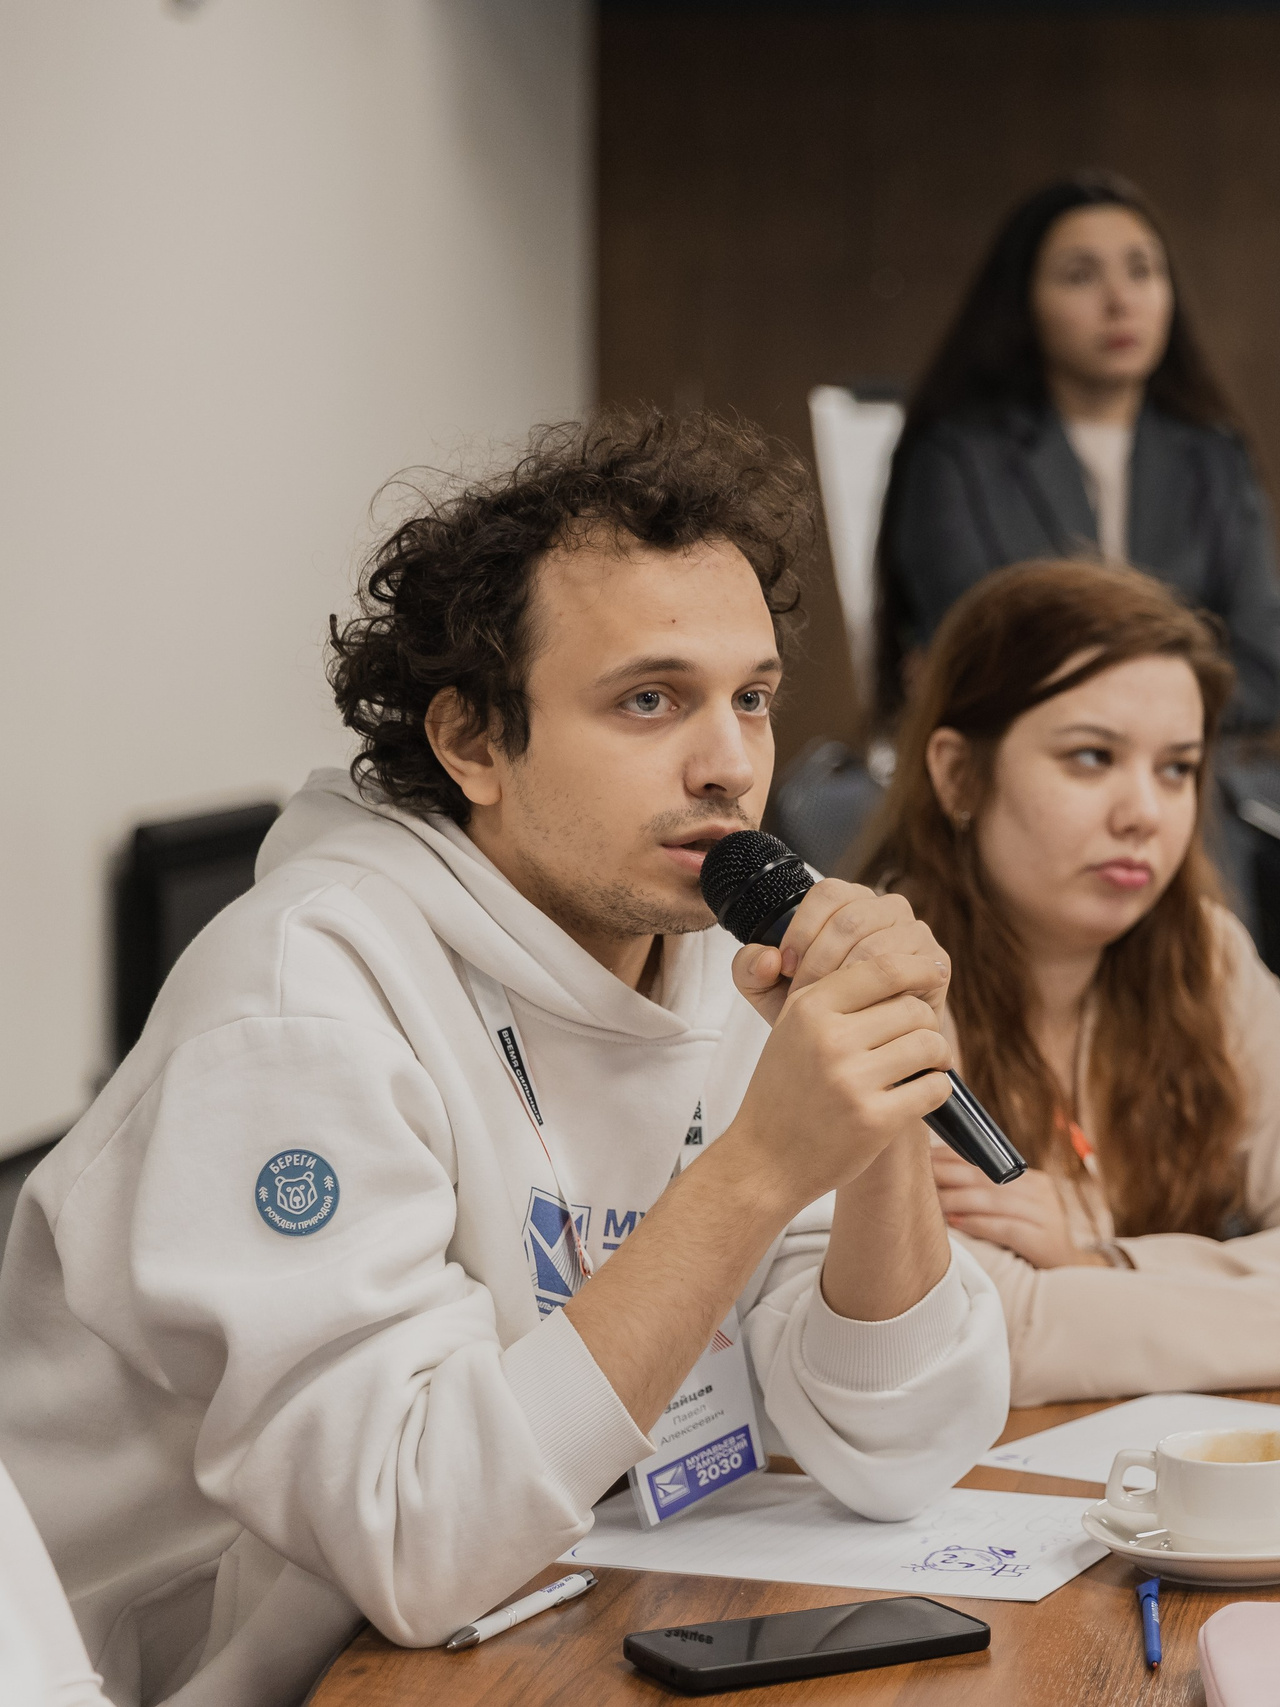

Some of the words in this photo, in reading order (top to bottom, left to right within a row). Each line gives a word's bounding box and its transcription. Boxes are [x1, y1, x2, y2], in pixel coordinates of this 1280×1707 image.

[501, 1030, 519, 1068] ВРЕМЯ
[269, 1154, 317, 1175] БЕРЕГИ
[264, 1206, 297, 1230] РОЖДЕН
[297, 1195, 334, 1230] ПРИРОДОЙ
[664, 1384, 713, 1414] Зайцев
[696, 1452, 743, 1486] 2030
